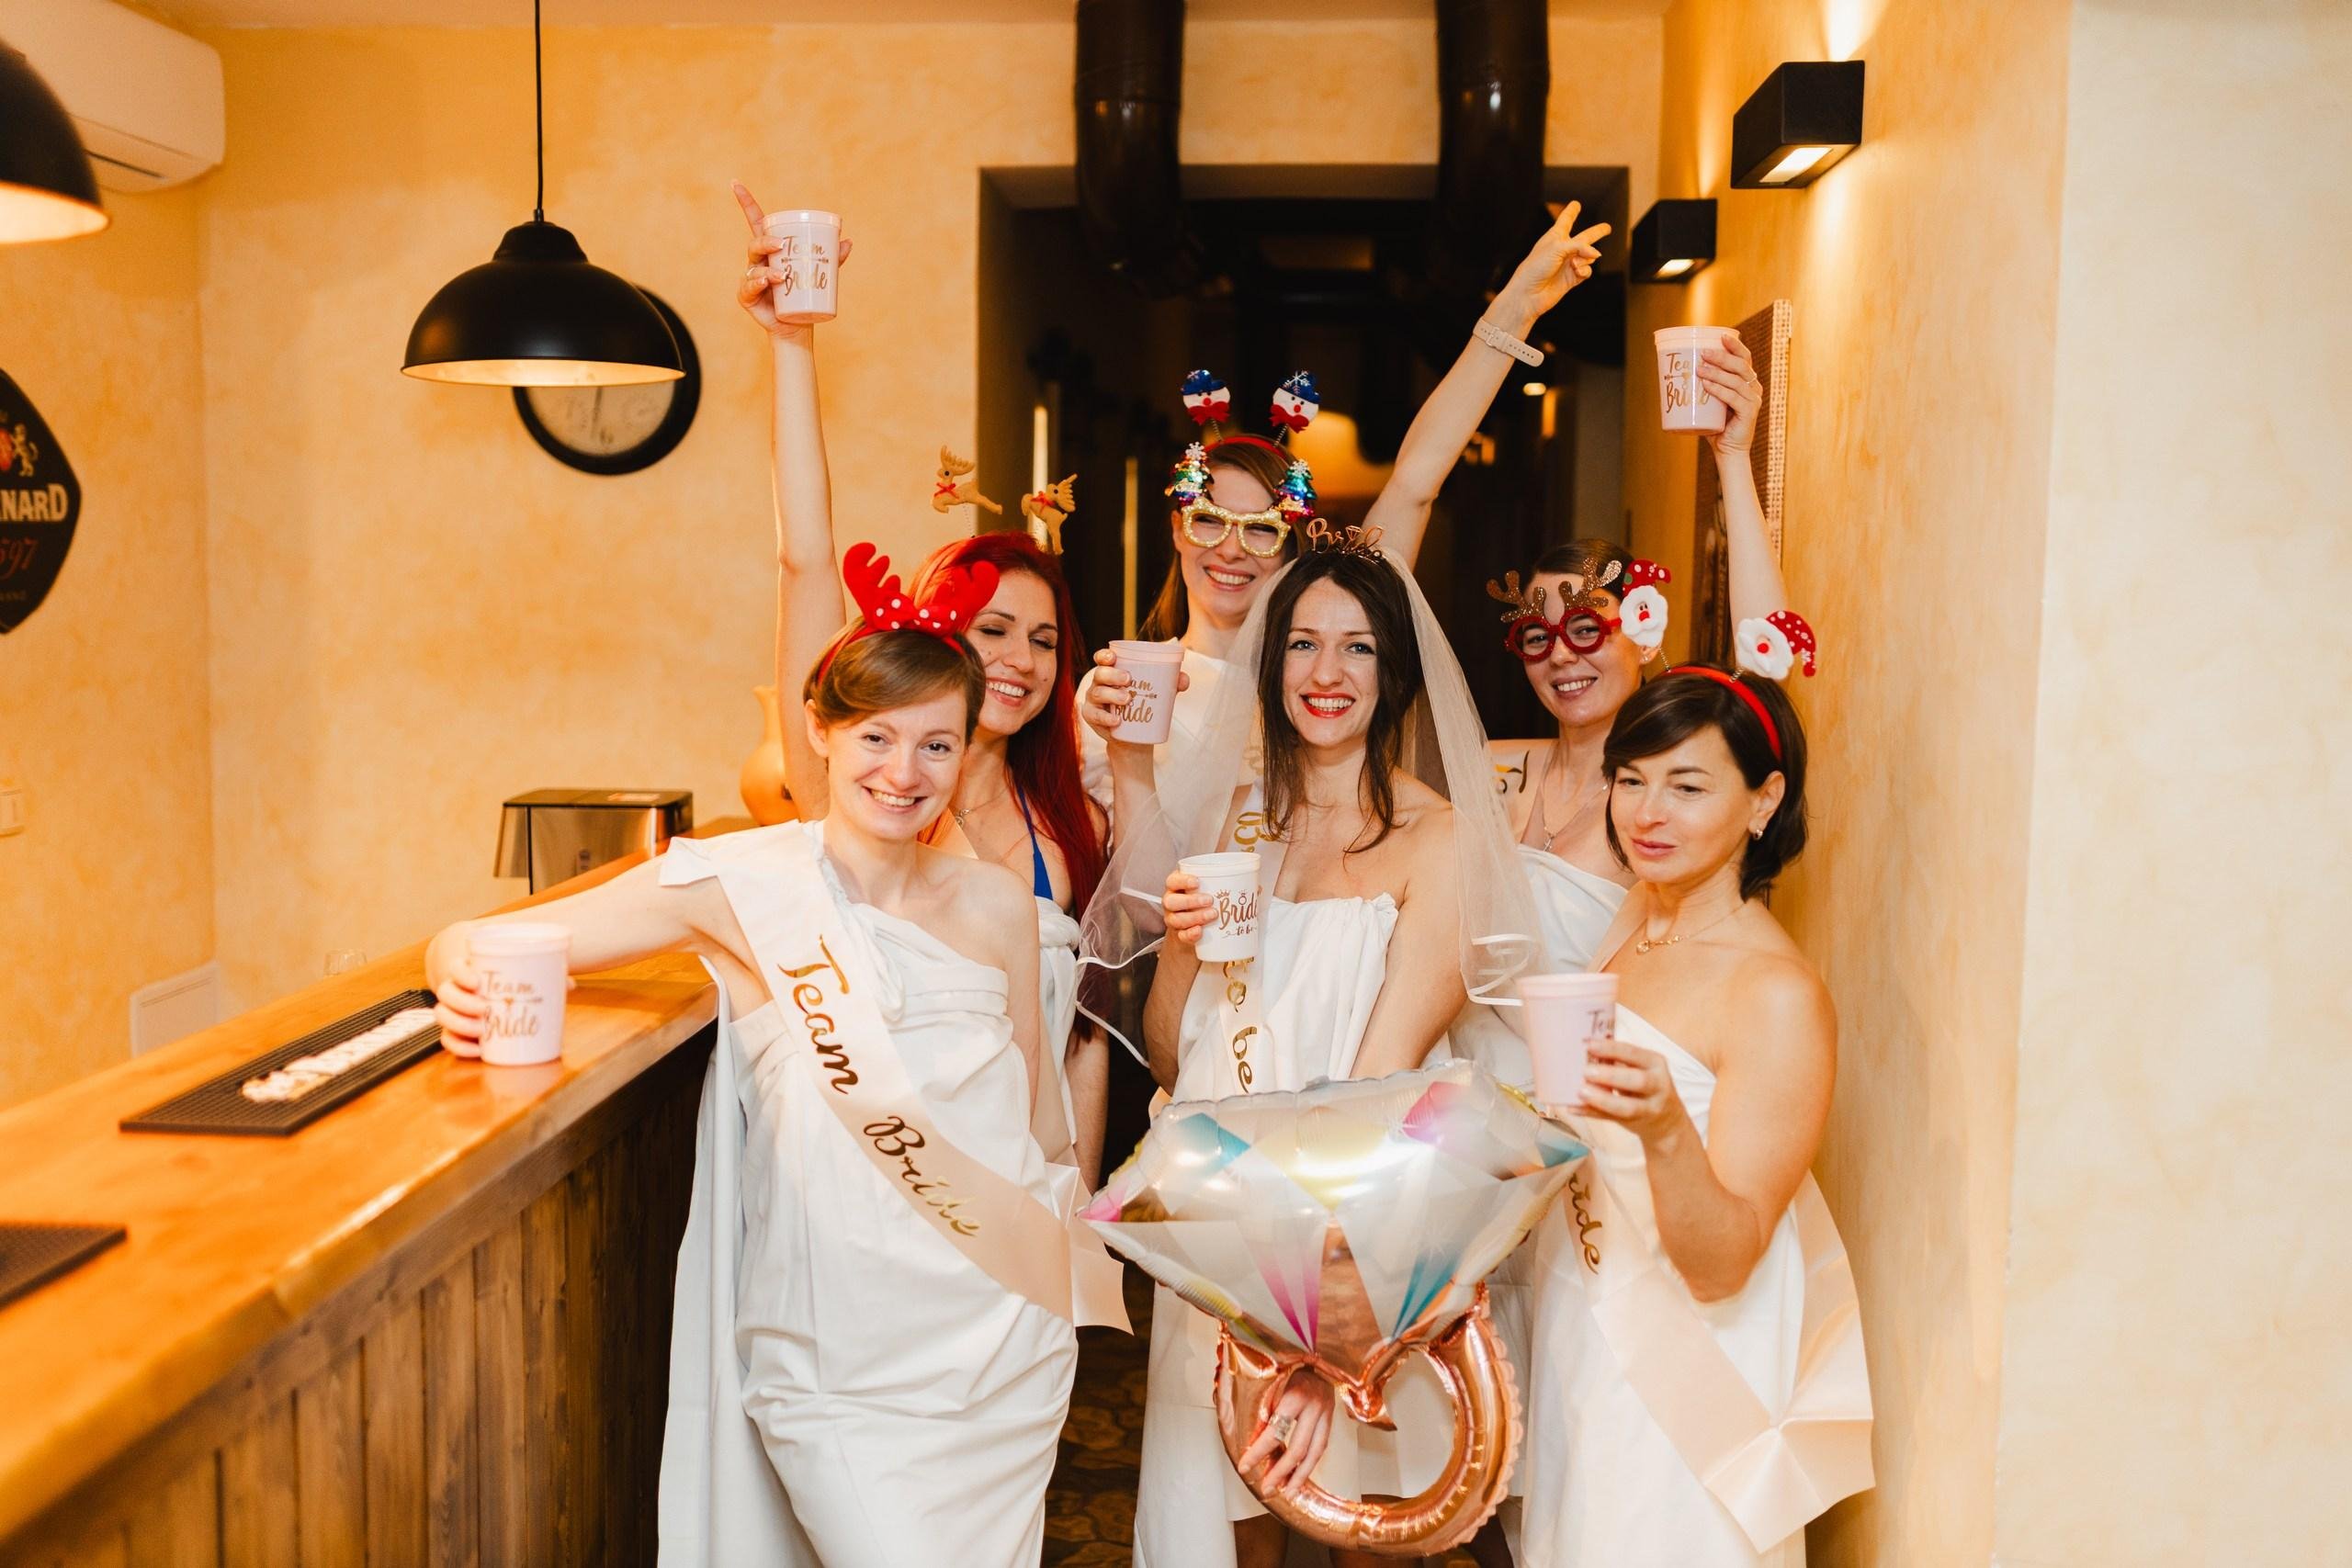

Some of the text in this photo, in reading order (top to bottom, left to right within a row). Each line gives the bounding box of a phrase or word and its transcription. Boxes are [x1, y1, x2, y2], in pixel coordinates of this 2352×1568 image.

[782, 235, 826, 256] Tem
[784, 264, 828, 297] Brde
[1666, 352, 1691, 374] Tea
[1666, 380, 1711, 413] Bri
[1115, 699, 1154, 723] ride
[1218, 891, 1258, 931] Brid
[1232, 1026, 1258, 1094] be
[776, 933, 980, 1236] Team Bride
[1568, 1172, 1603, 1276] ride
